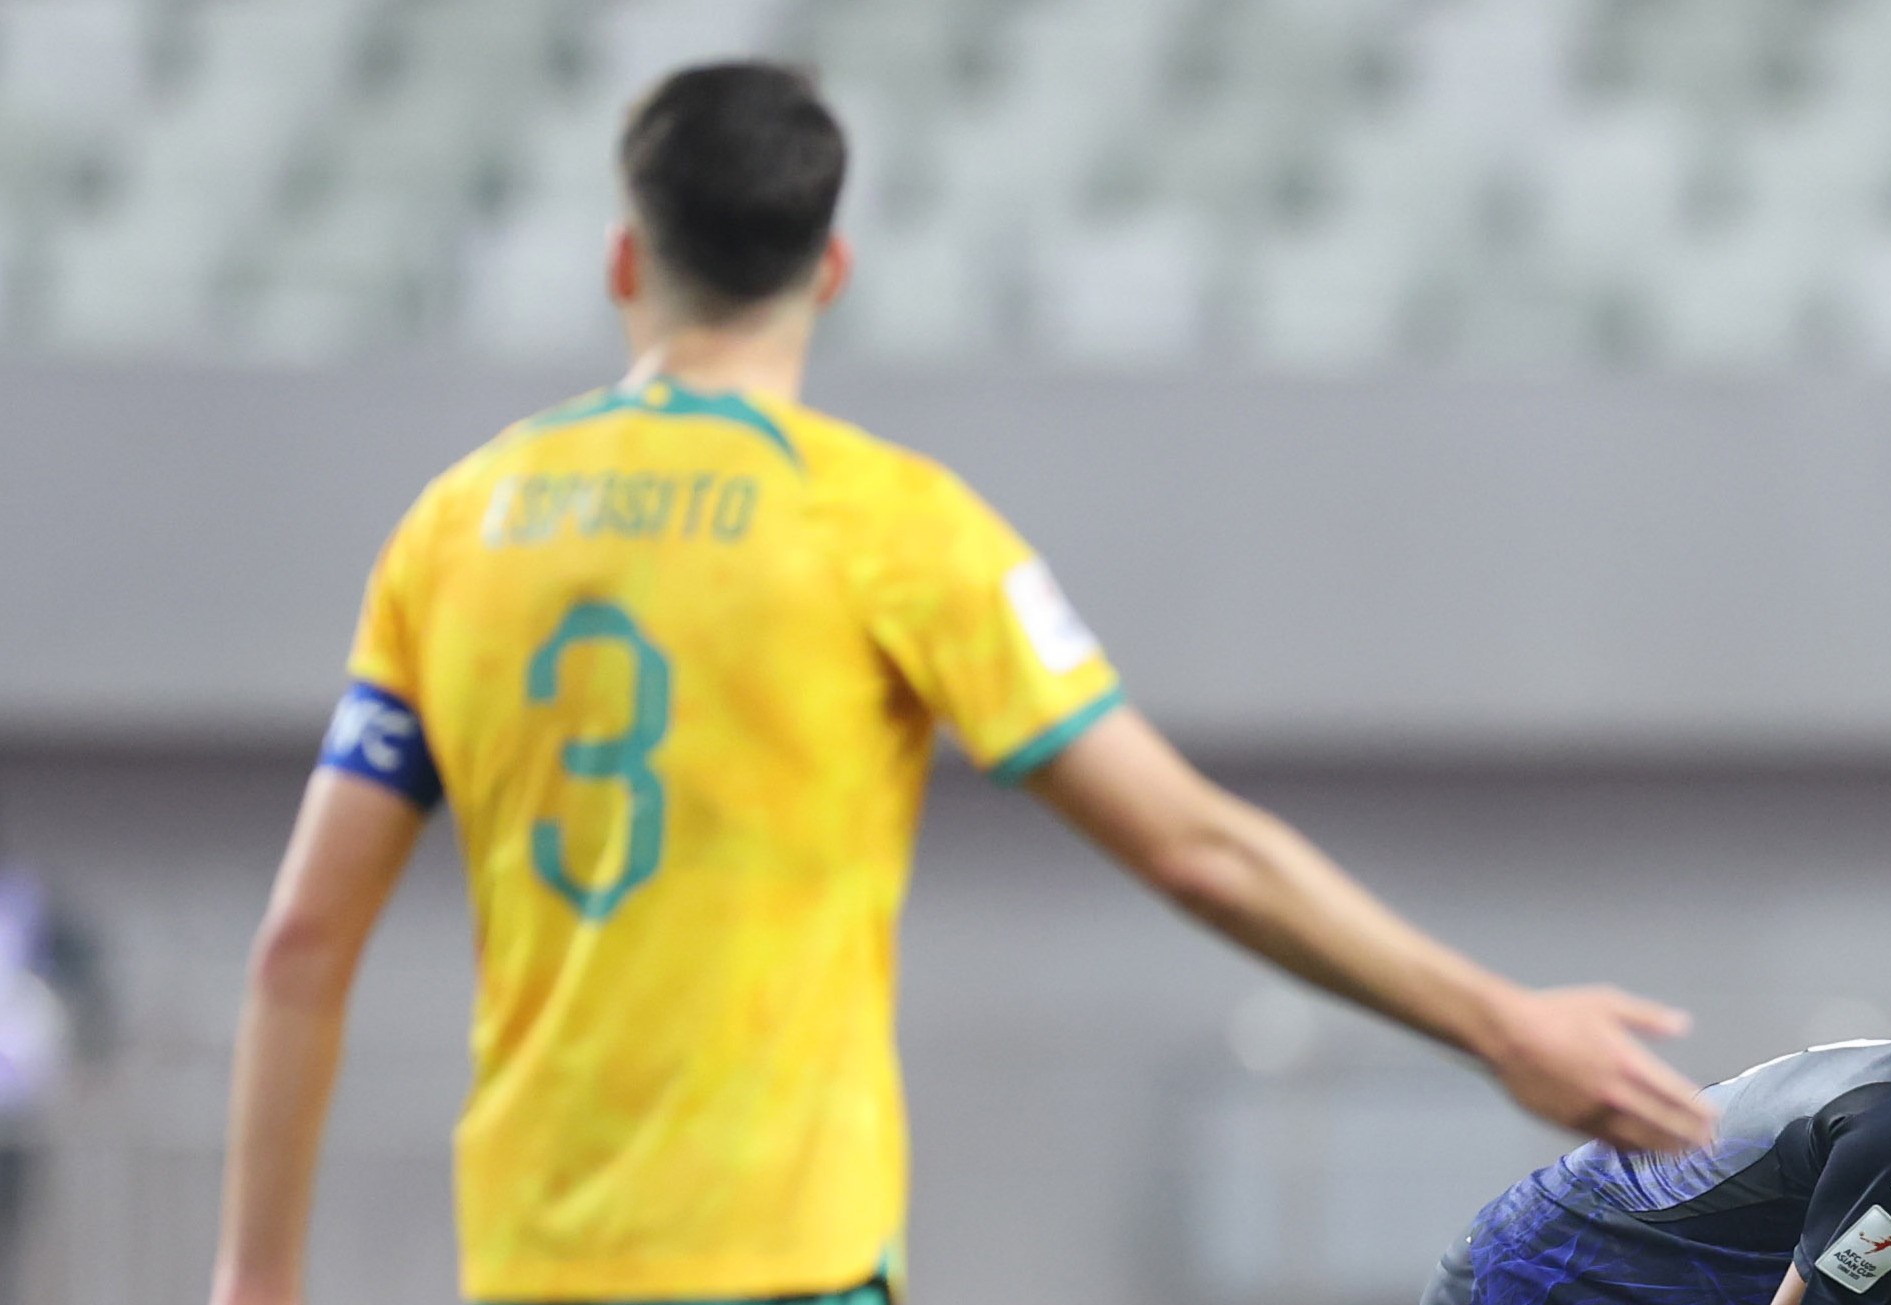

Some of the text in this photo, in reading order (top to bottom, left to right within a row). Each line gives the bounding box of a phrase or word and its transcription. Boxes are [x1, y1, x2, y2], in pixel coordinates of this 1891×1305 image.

[526, 598, 672, 923] 3
[1834, 1252, 1857, 1272] ASIAN
[1857, 1268, 1876, 1278] CUP
[1844, 1249, 1861, 1263] AFC
